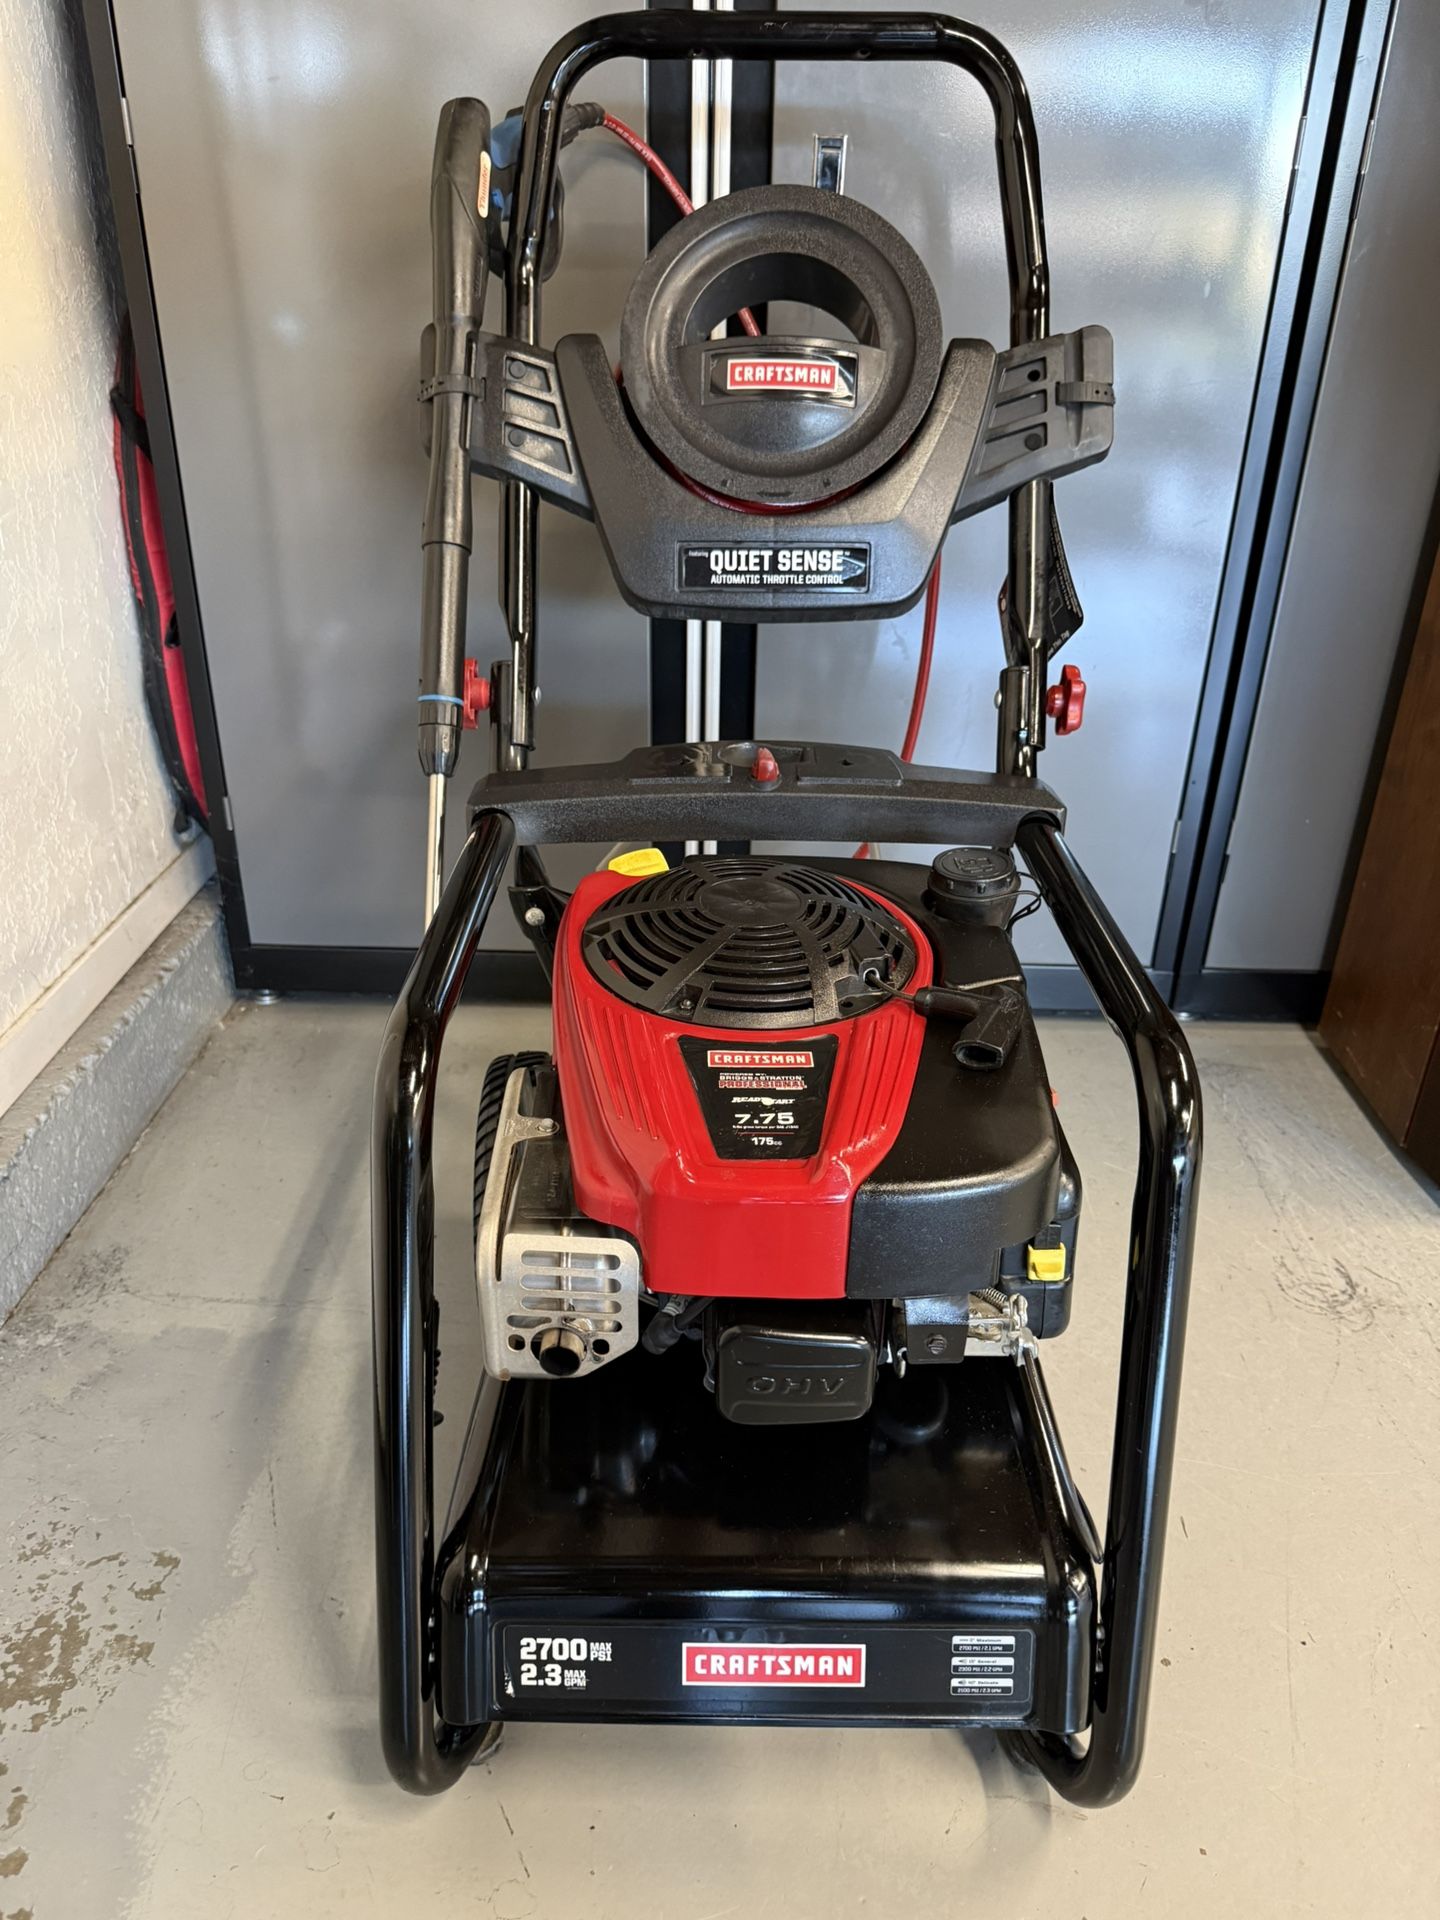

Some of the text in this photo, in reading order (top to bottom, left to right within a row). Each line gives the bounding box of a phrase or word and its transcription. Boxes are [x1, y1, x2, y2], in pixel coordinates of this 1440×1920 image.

[734, 366, 832, 385] CRAFTSMAN
[709, 550, 773, 574] QUIET
[777, 550, 844, 571] SENSE
[710, 574, 844, 585] AUTOMATIC THROTTLE CONTROL
[714, 1054, 806, 1064] CRAFTSMAN
[719, 1080, 805, 1088] PROFESSIONAL
[735, 1112, 794, 1124] 7.75
[748, 1377, 844, 1394] OHV
[520, 1637, 612, 1661] 2700 MAX
[590, 1651, 612, 1661] PSI
[694, 1654, 853, 1676] CRAFTSMAN
[521, 1663, 586, 1686] 2.3 MAX
[564, 1678, 587, 1687] GPM
